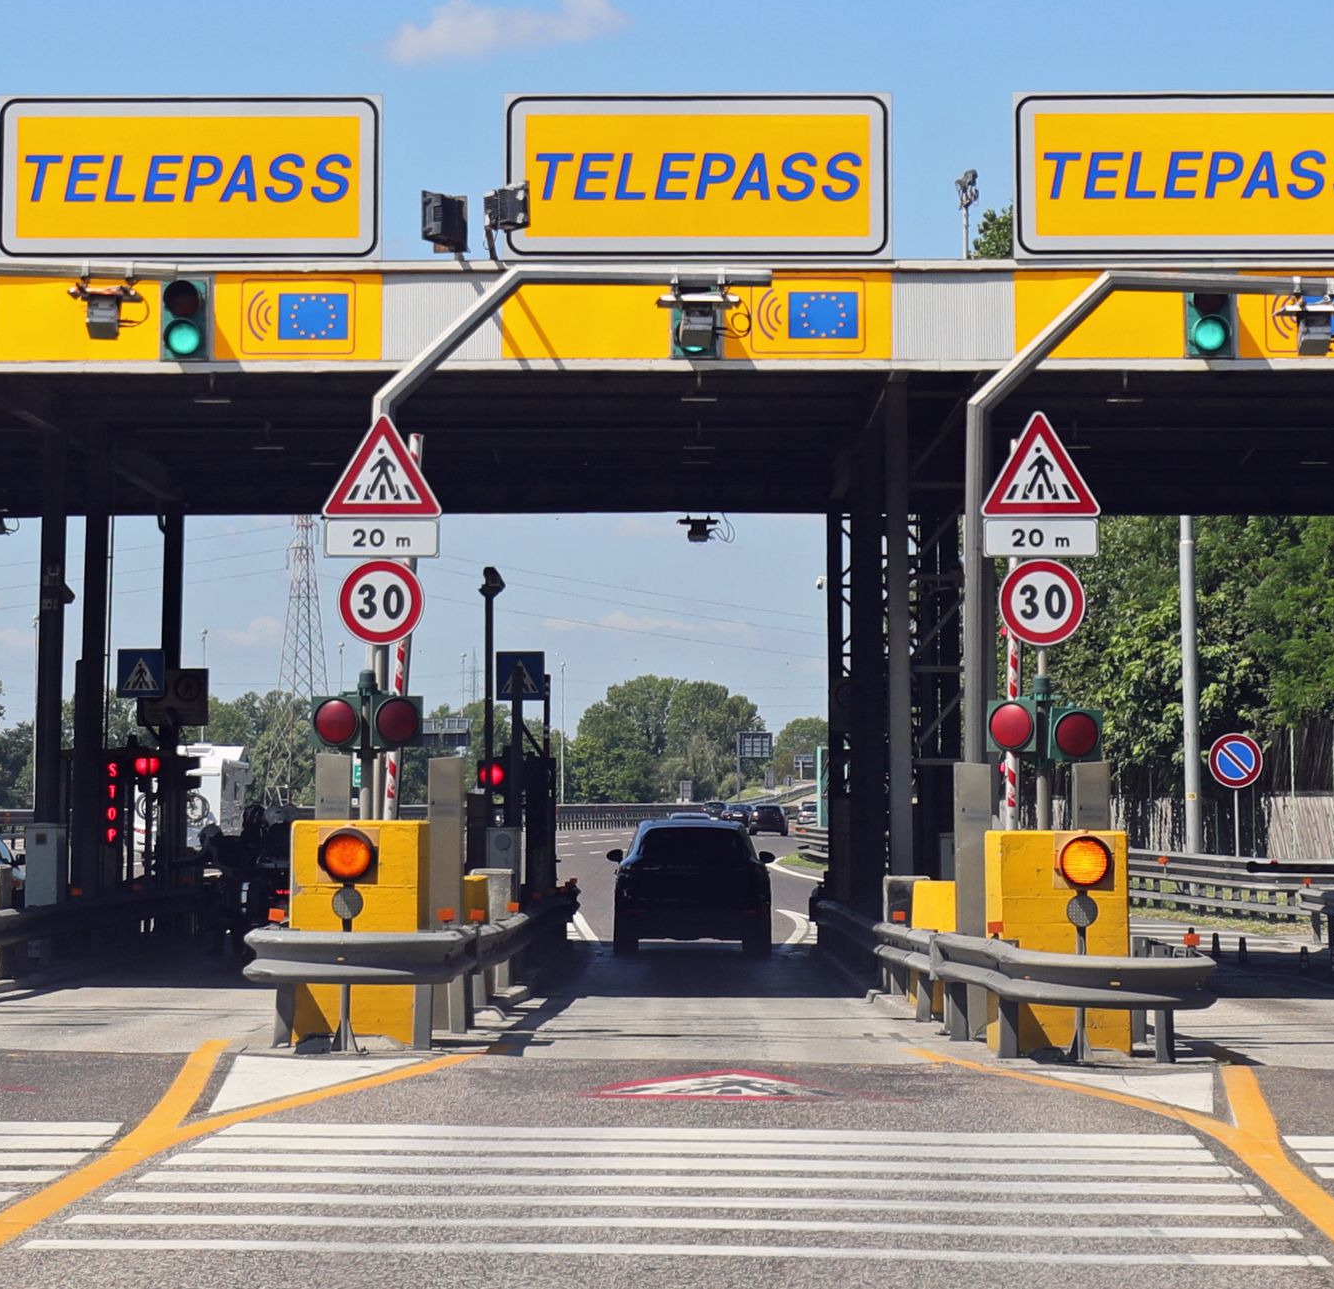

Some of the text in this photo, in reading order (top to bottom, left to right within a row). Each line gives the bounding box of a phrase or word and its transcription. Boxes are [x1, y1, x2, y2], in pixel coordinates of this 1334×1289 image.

[25, 153, 353, 203] TELEPASS
[535, 152, 863, 201] TELEPASS
[352, 528, 411, 548] 20 m
[1011, 528, 1070, 548] 20 m
[357, 583, 404, 621] 30
[1020, 583, 1066, 621] 30
[107, 762, 118, 842] STOP
